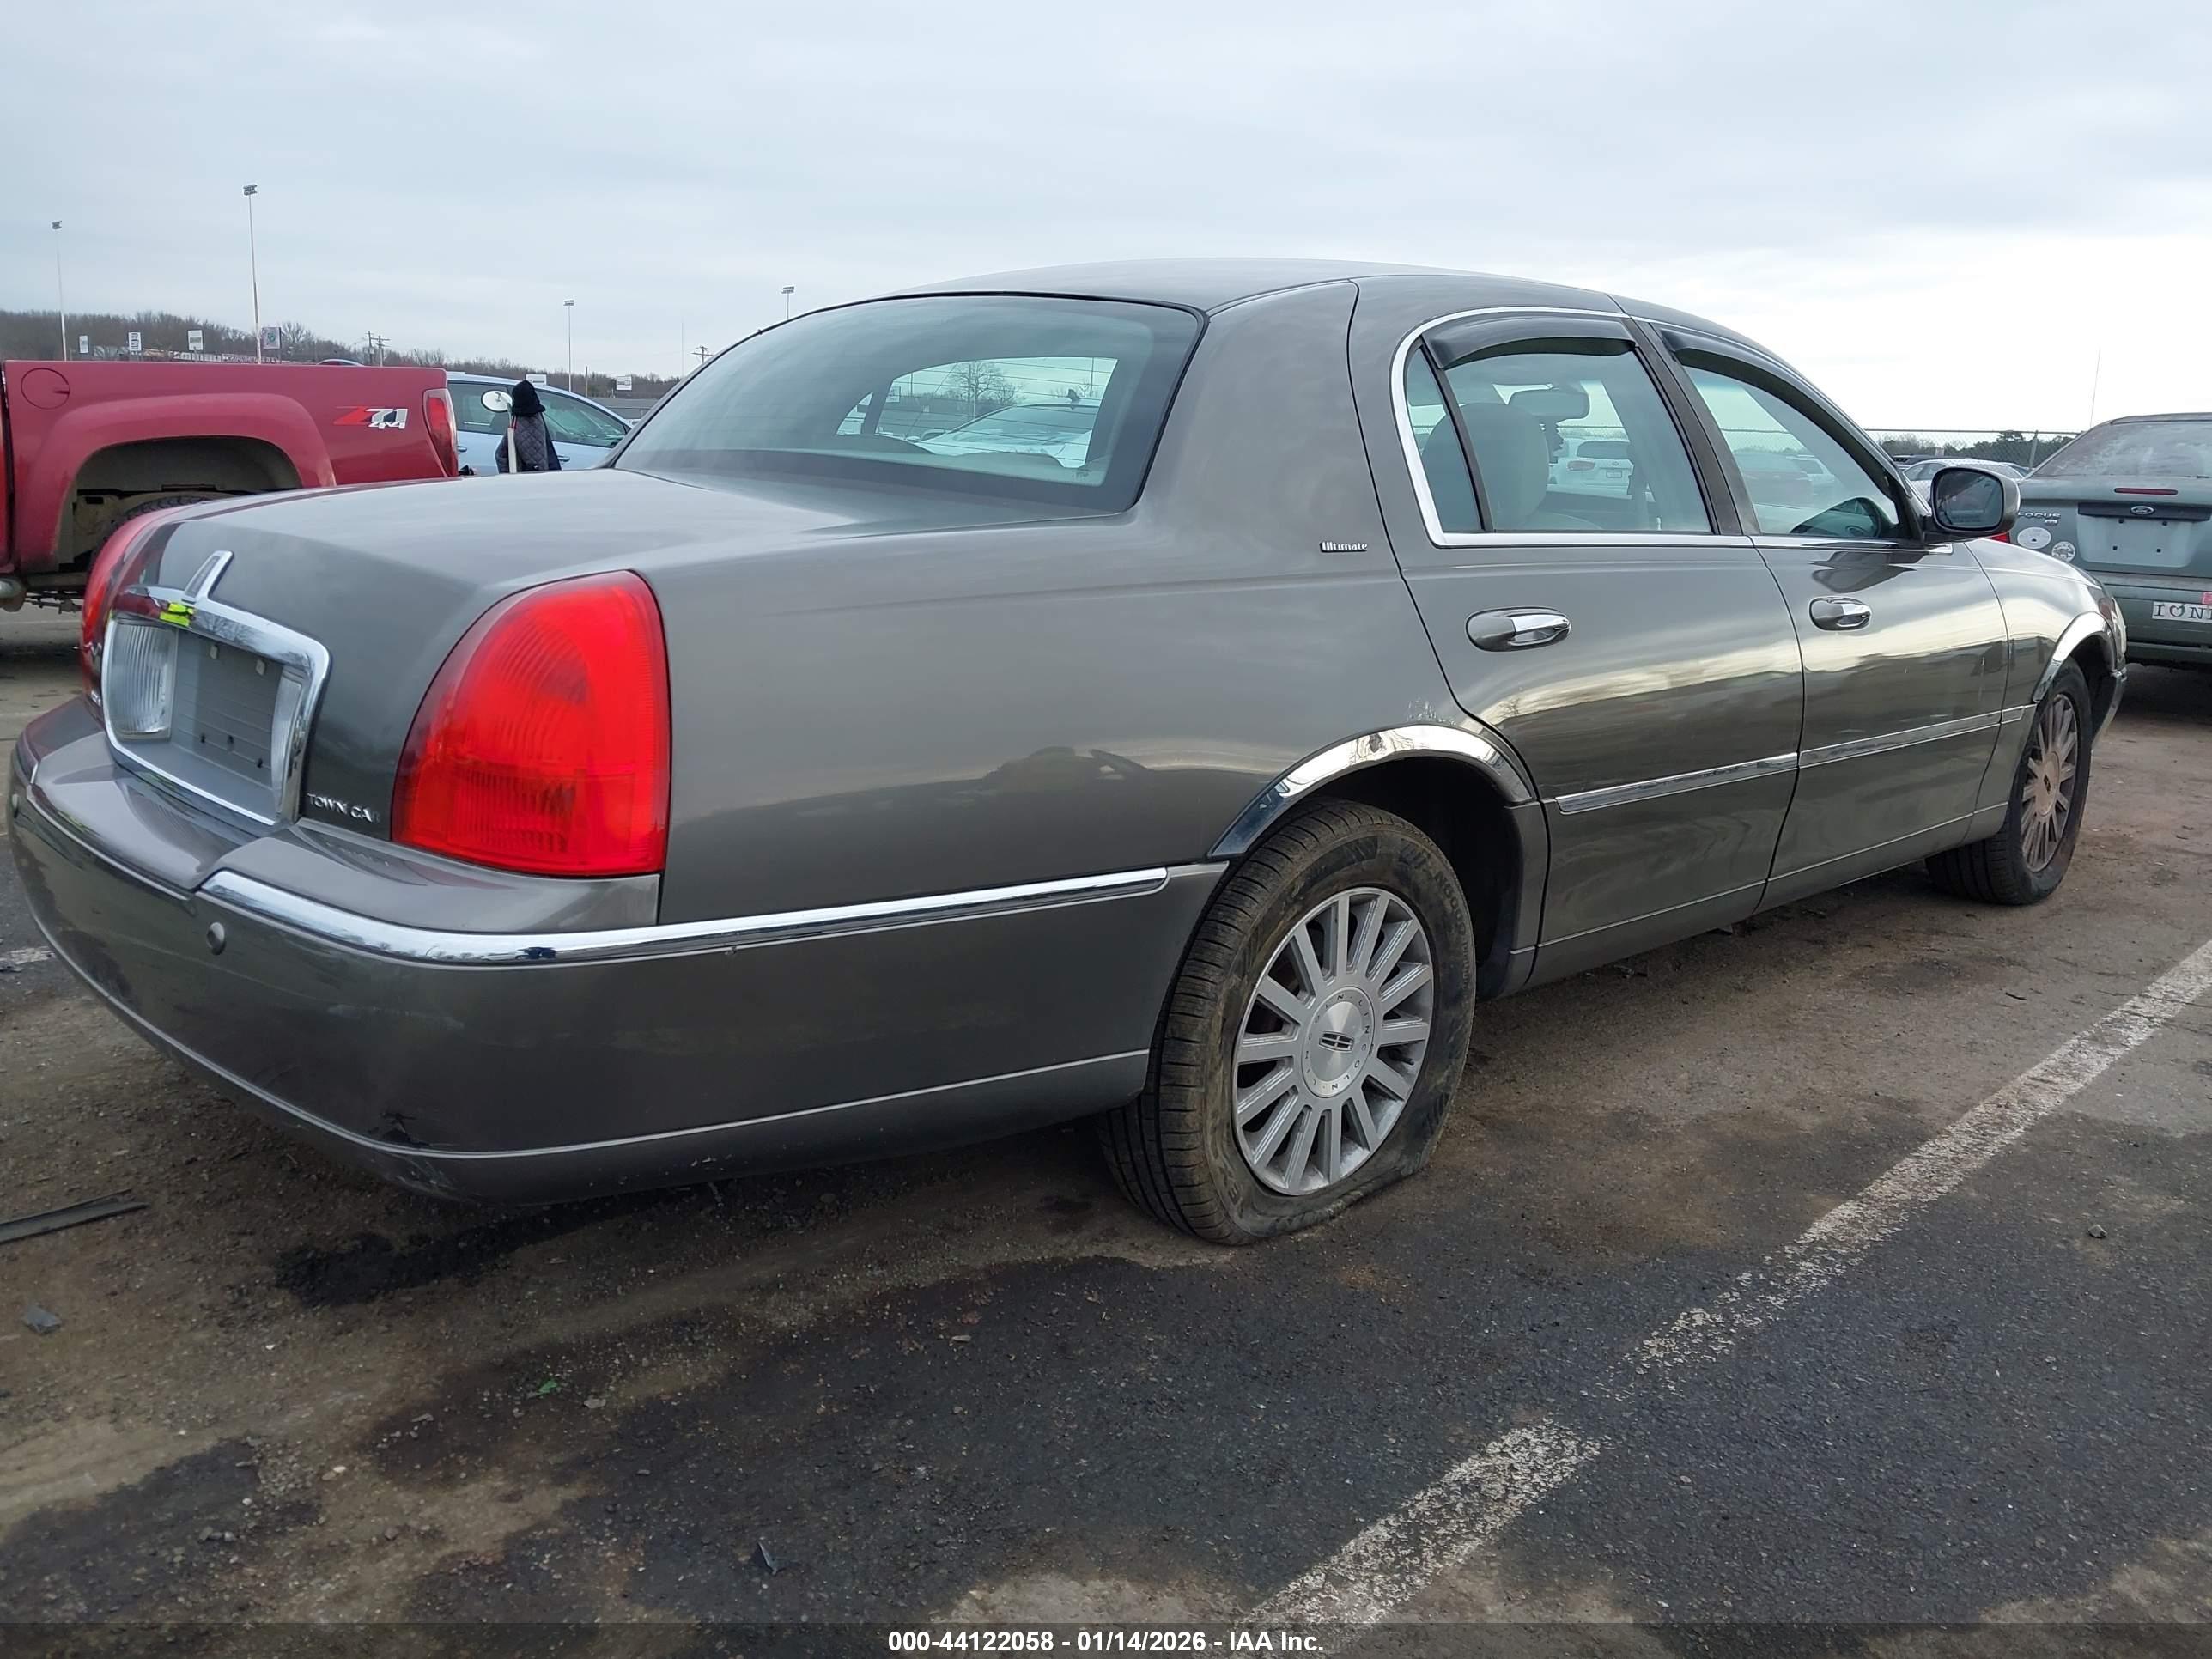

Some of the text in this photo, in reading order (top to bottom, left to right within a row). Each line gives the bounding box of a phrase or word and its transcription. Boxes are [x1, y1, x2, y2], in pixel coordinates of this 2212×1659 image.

[334, 406, 408, 426] Z71
[2018, 511, 2062, 520] FOCUS
[1320, 541, 1368, 552] Ultimate
[307, 793, 348, 814] TOWN
